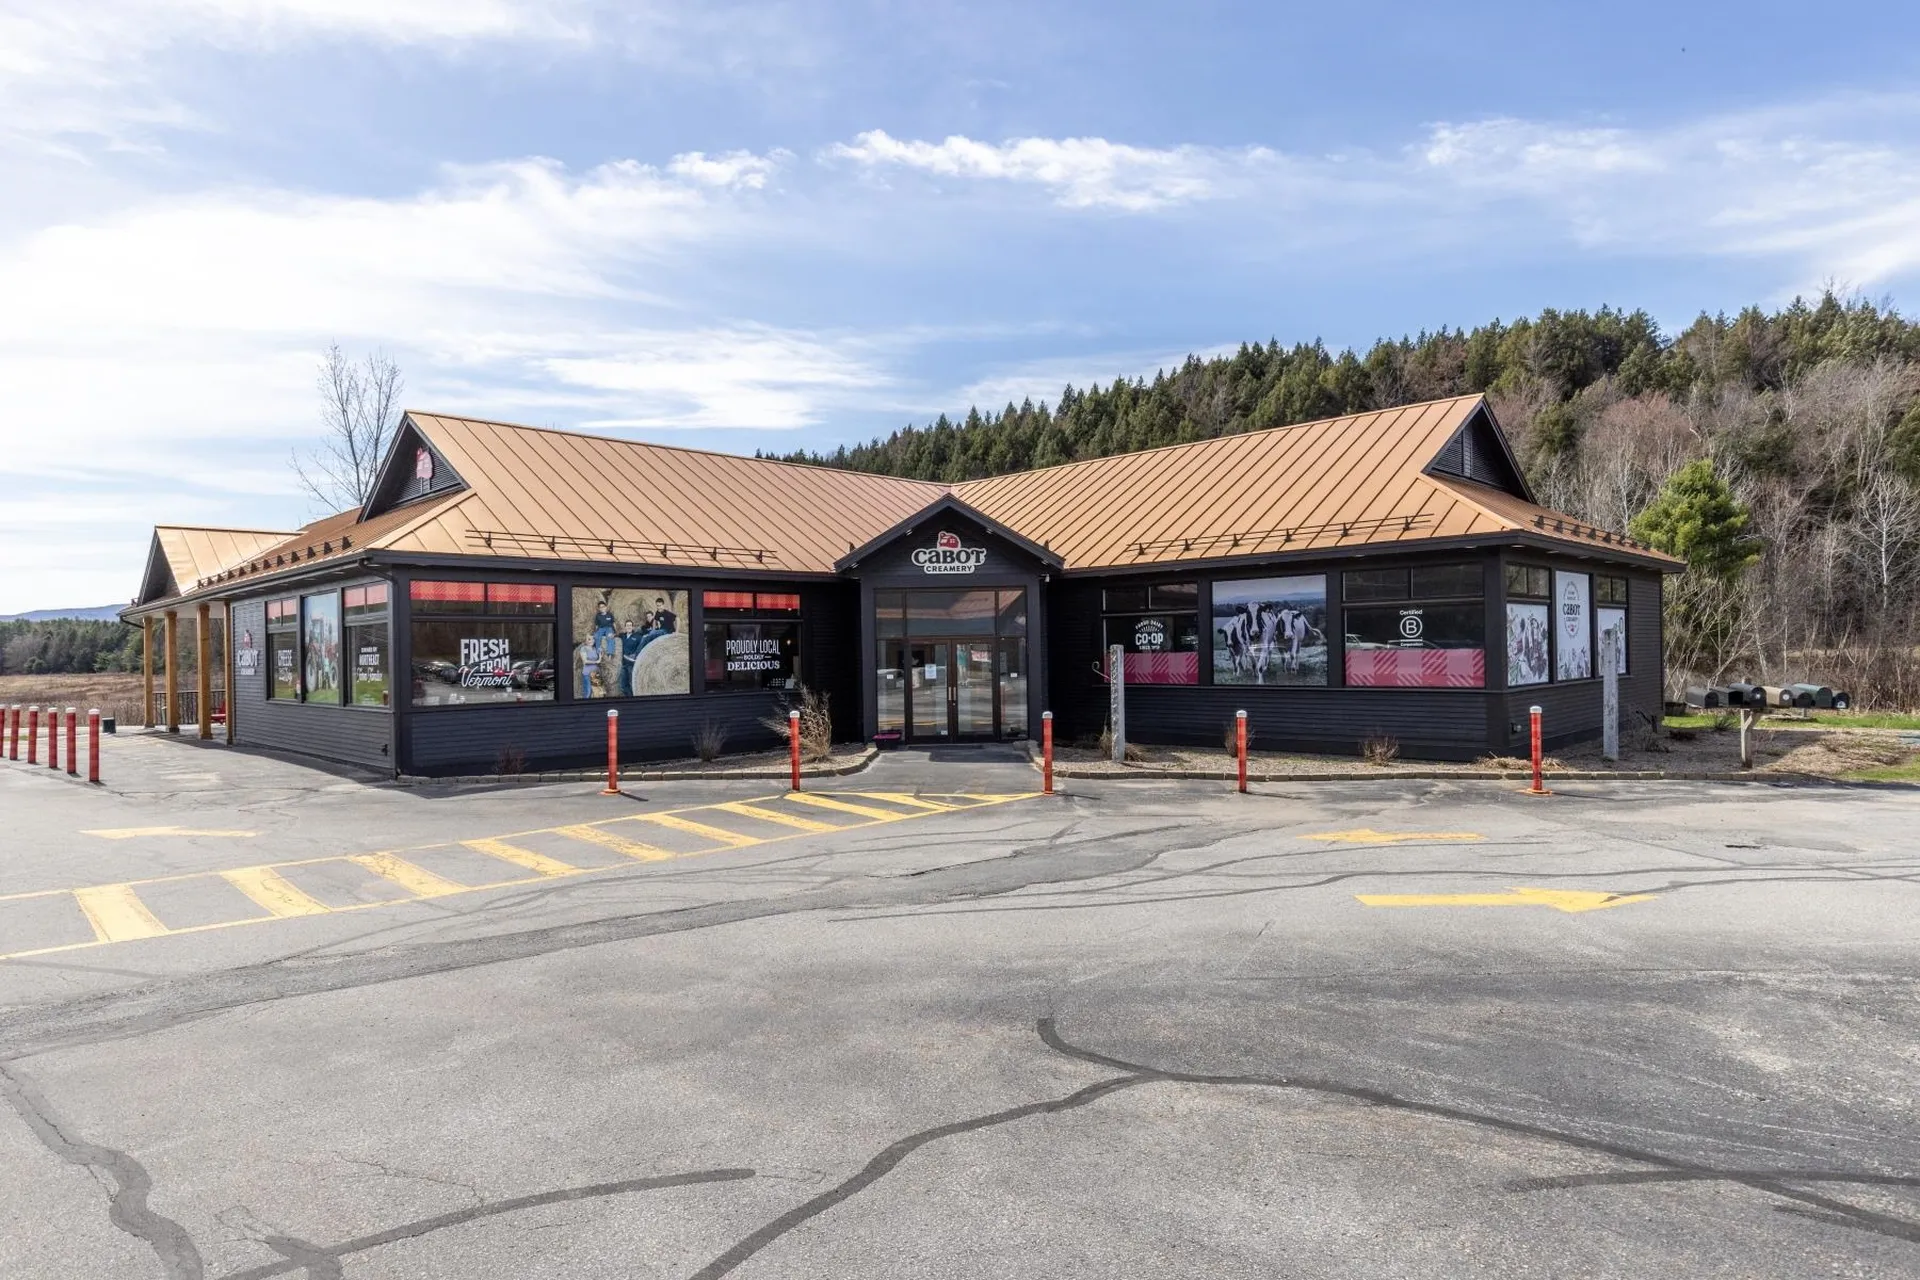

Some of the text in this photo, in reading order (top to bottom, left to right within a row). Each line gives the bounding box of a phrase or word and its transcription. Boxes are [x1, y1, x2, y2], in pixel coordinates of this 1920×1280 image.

[925, 565, 973, 573] CREAMERY
[1406, 620, 1417, 633] B
[460, 638, 509, 666] FRESH
[725, 639, 780, 656] PROUDLY LOCAL
[480, 655, 510, 673] FROM
[727, 660, 781, 671] DELICIOUS
[458, 665, 515, 689] Vermont
